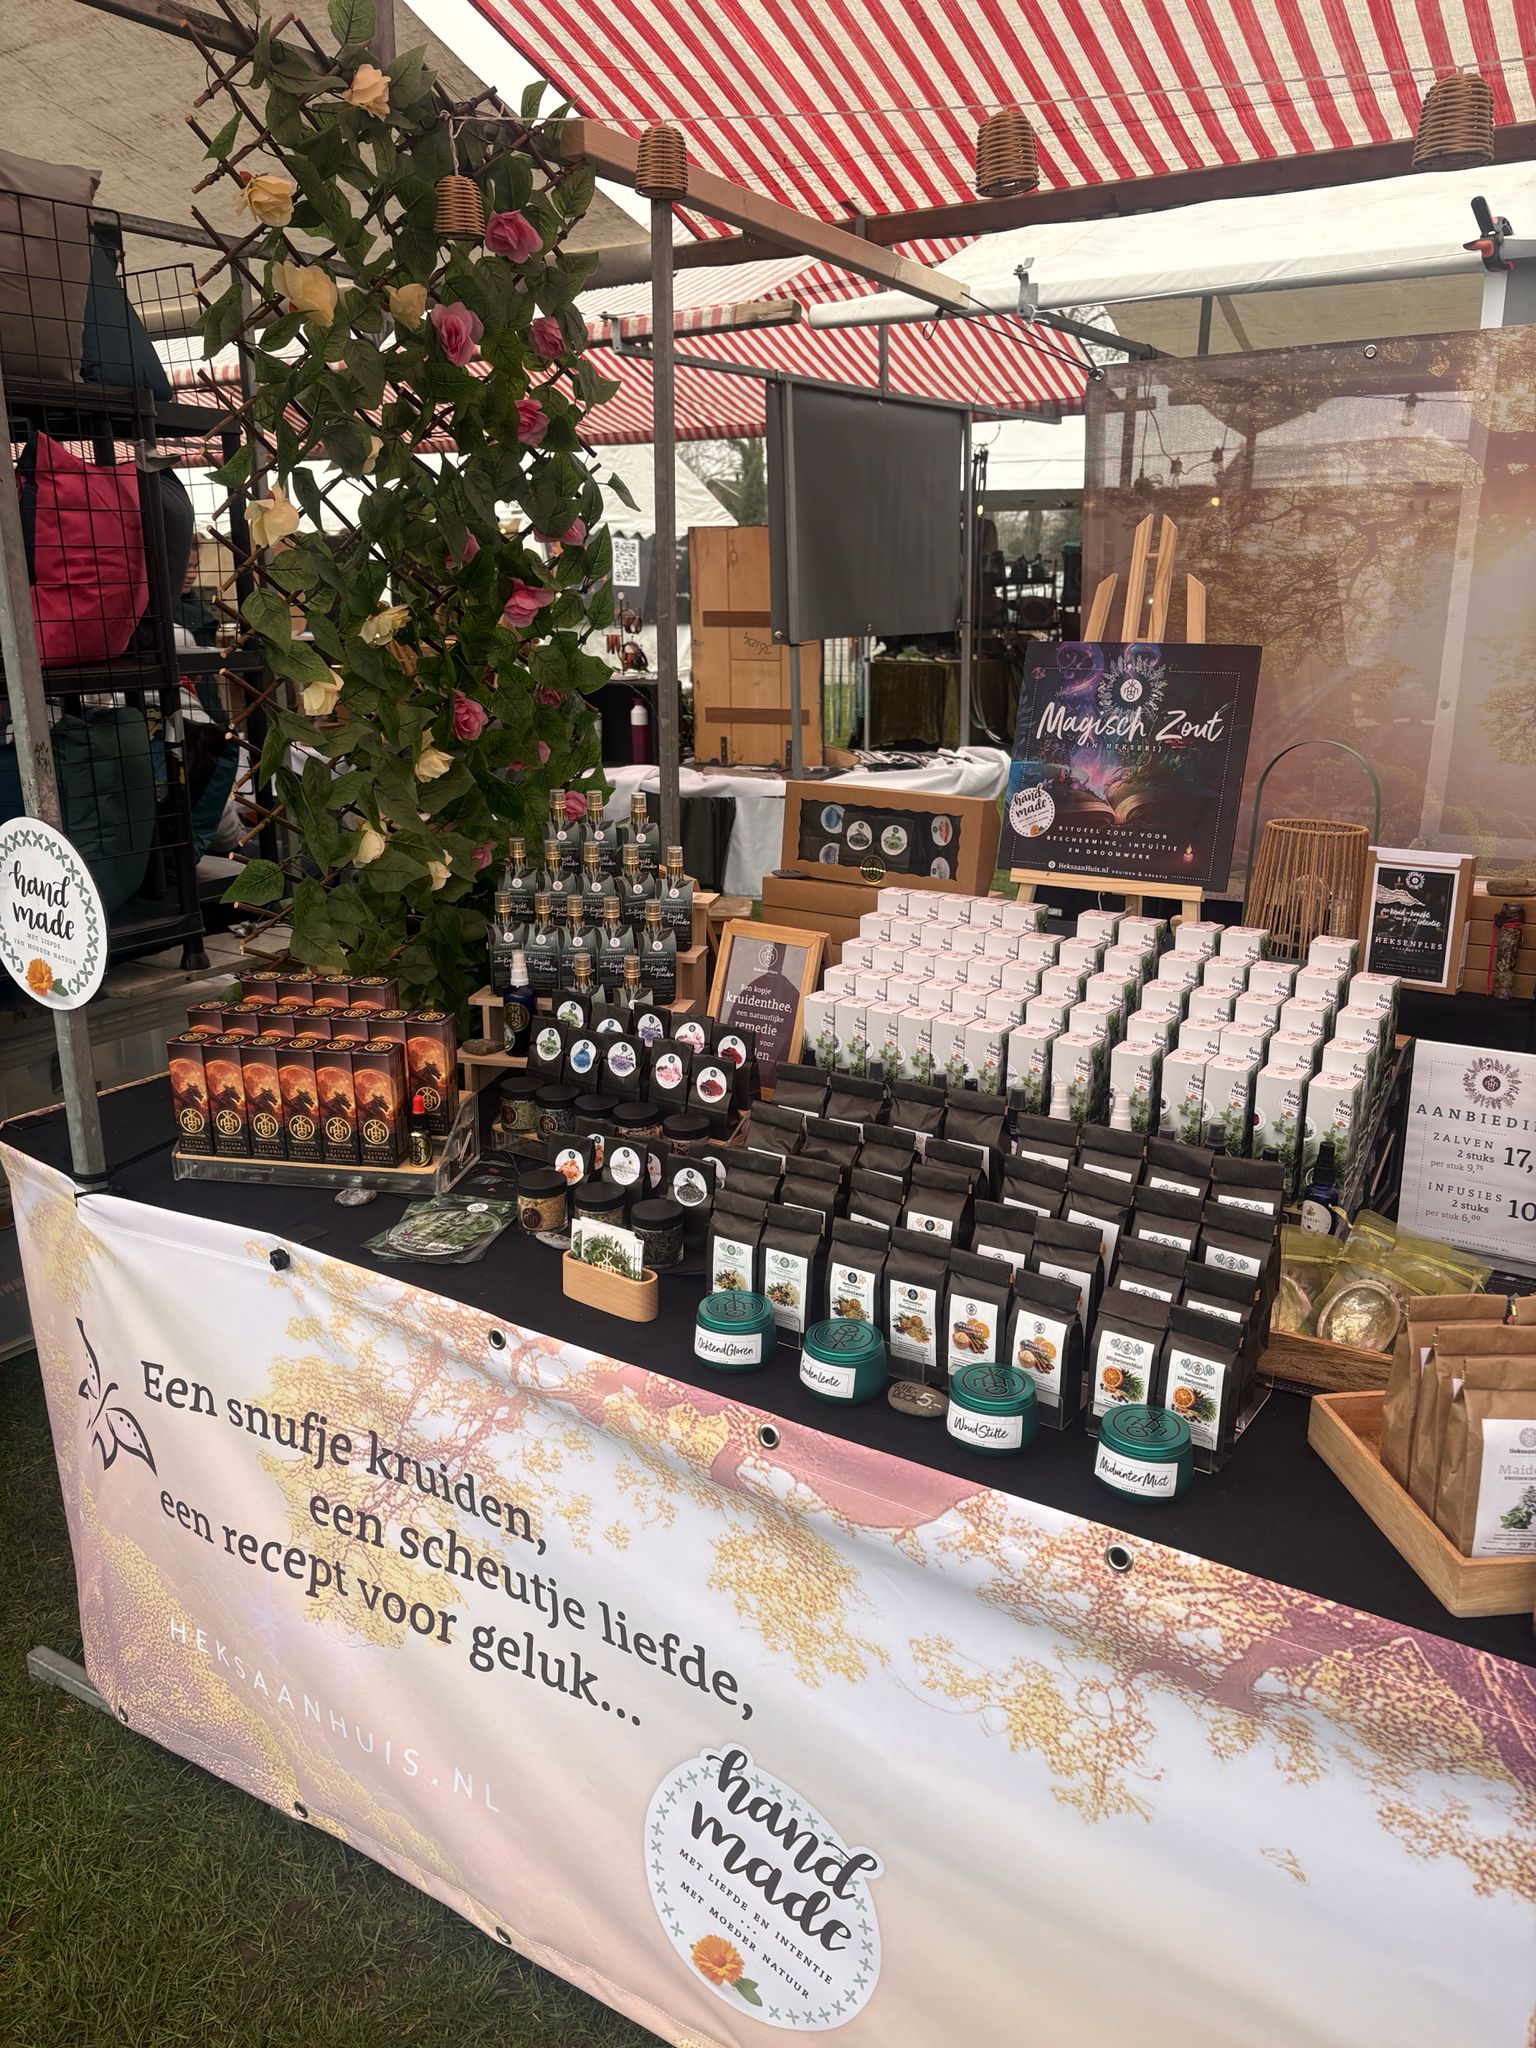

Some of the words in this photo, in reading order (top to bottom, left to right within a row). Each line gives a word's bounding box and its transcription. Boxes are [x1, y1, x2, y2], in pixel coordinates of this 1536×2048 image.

[1036, 702, 1146, 745] Magisch
[1156, 706, 1226, 742] Zout
[1106, 743, 1162, 753] HEKSERIJ
[1014, 783, 1042, 807] hand
[1015, 799, 1047, 818] made
[1059, 826, 1100, 834] RITUEEL
[1141, 832, 1167, 840] VOOR
[1047, 835, 1122, 847] BESCHERMING,
[1129, 842, 1178, 852] INTUÏTIE
[1086, 849, 1150, 860] DROOMWERK
[1058, 863, 1109, 873] HeksaanHuis.nl
[9, 860, 70, 908] hand
[13, 902, 74, 941] made
[1375, 936, 1443, 950] HEKSENFLES
[53, 950, 77, 966] NATUUR
[741, 984, 752, 992] Een
[754, 985, 772, 996] kopje
[737, 1009, 748, 1017] een
[749, 1011, 784, 1023] natuurlijke
[735, 1020, 777, 1036] remedie
[760, 1040, 774, 1048] voor
[1433, 1132, 1494, 1149] ZALVEN
[1430, 1160, 1444, 1170] per
[1446, 1160, 1465, 1171] stuk
[1467, 1164, 1484, 1174] 9,75
[1457, 1149, 1463, 1158] 2
[1466, 1151, 1495, 1163] stuks
[1503, 1146, 1534, 1173] 17,
[1428, 1181, 1502, 1202] INFUSIES
[1425, 1208, 1439, 1218] per
[1441, 1210, 1460, 1221] stuk
[1461, 1214, 1481, 1224] 6,00
[1451, 1199, 1458, 1208] 2
[1461, 1201, 1489, 1214] stuks
[954, 1416, 1008, 1440] WoudStilte
[141, 1360, 217, 1417] Een
[227, 1398, 352, 1469] snufje
[366, 1430, 546, 1556] kruiden,
[1099, 1456, 1170, 1488] MidwinterMist
[160, 1490, 215, 1544] een
[222, 1525, 348, 1598] recept
[357, 1576, 458, 1644] voor
[470, 1625, 641, 1726] geluk...
[310, 1495, 384, 1548] een
[399, 1526, 585, 1629] scheutje
[598, 1601, 753, 1721] liefde,
[170, 1618, 499, 1813] HEKSAANHUIS.NL
[706, 1749, 878, 1900] hand
[691, 1800, 852, 1951] made
[679, 1848, 704, 1872] MET
[708, 1873, 748, 1912] LIEFDE
[753, 1912, 769, 1930] EN
[775, 1931, 832, 1985] INTENTIE
[680, 1881, 705, 1905] MET
[709, 1907, 756, 1953] MOEDER
[762, 1953, 810, 1999] NATUUR
